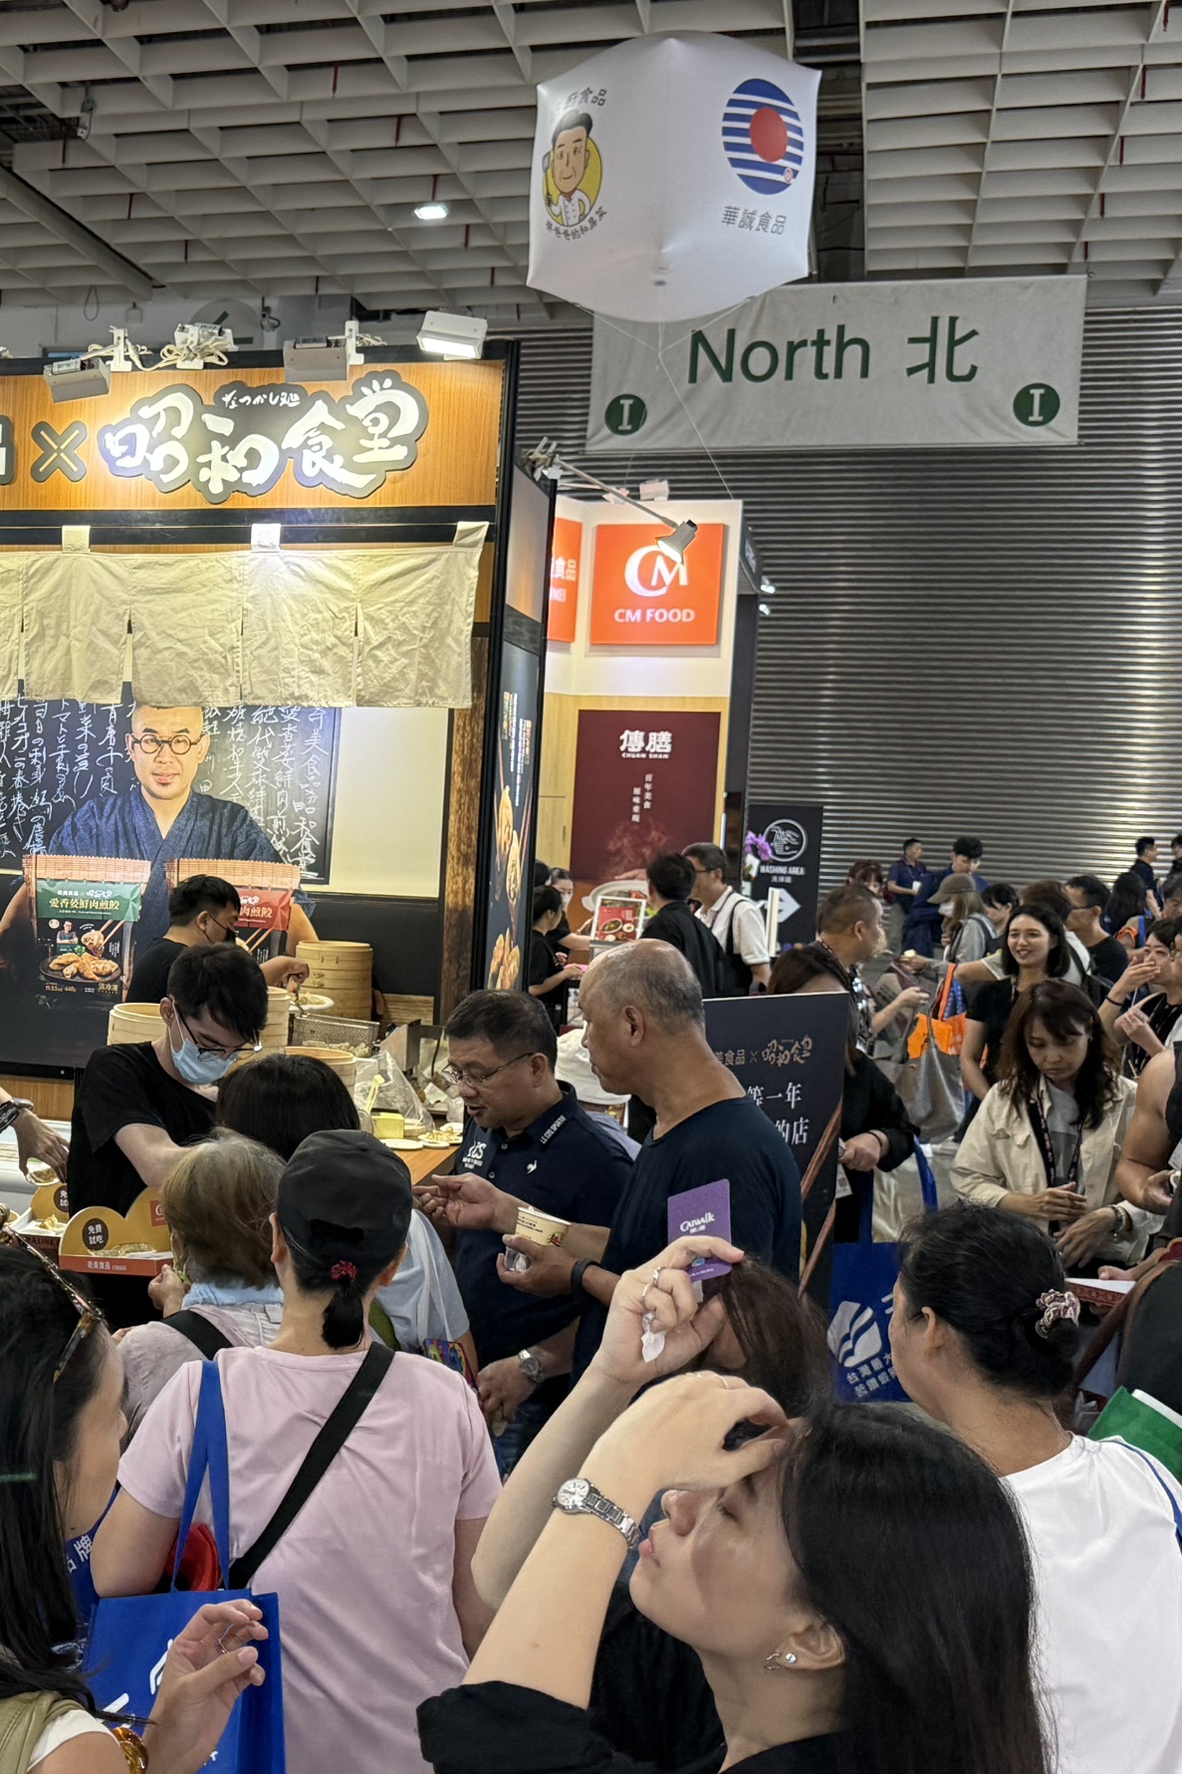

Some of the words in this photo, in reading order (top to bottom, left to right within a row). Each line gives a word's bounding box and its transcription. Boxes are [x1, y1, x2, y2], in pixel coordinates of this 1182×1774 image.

[722, 205, 787, 236] 華誠食品
[687, 324, 871, 385] North
[905, 315, 980, 384] 北
[104, 378, 420, 495] 昭和食堂
[550, 556, 577, 582] 食品
[613, 607, 642, 623] CM
[645, 607, 696, 623] FOOD
[788, 866, 806, 876] AREA
[88, 1223, 103, 1235] 免費
[88, 1235, 105, 1246] 試吃
